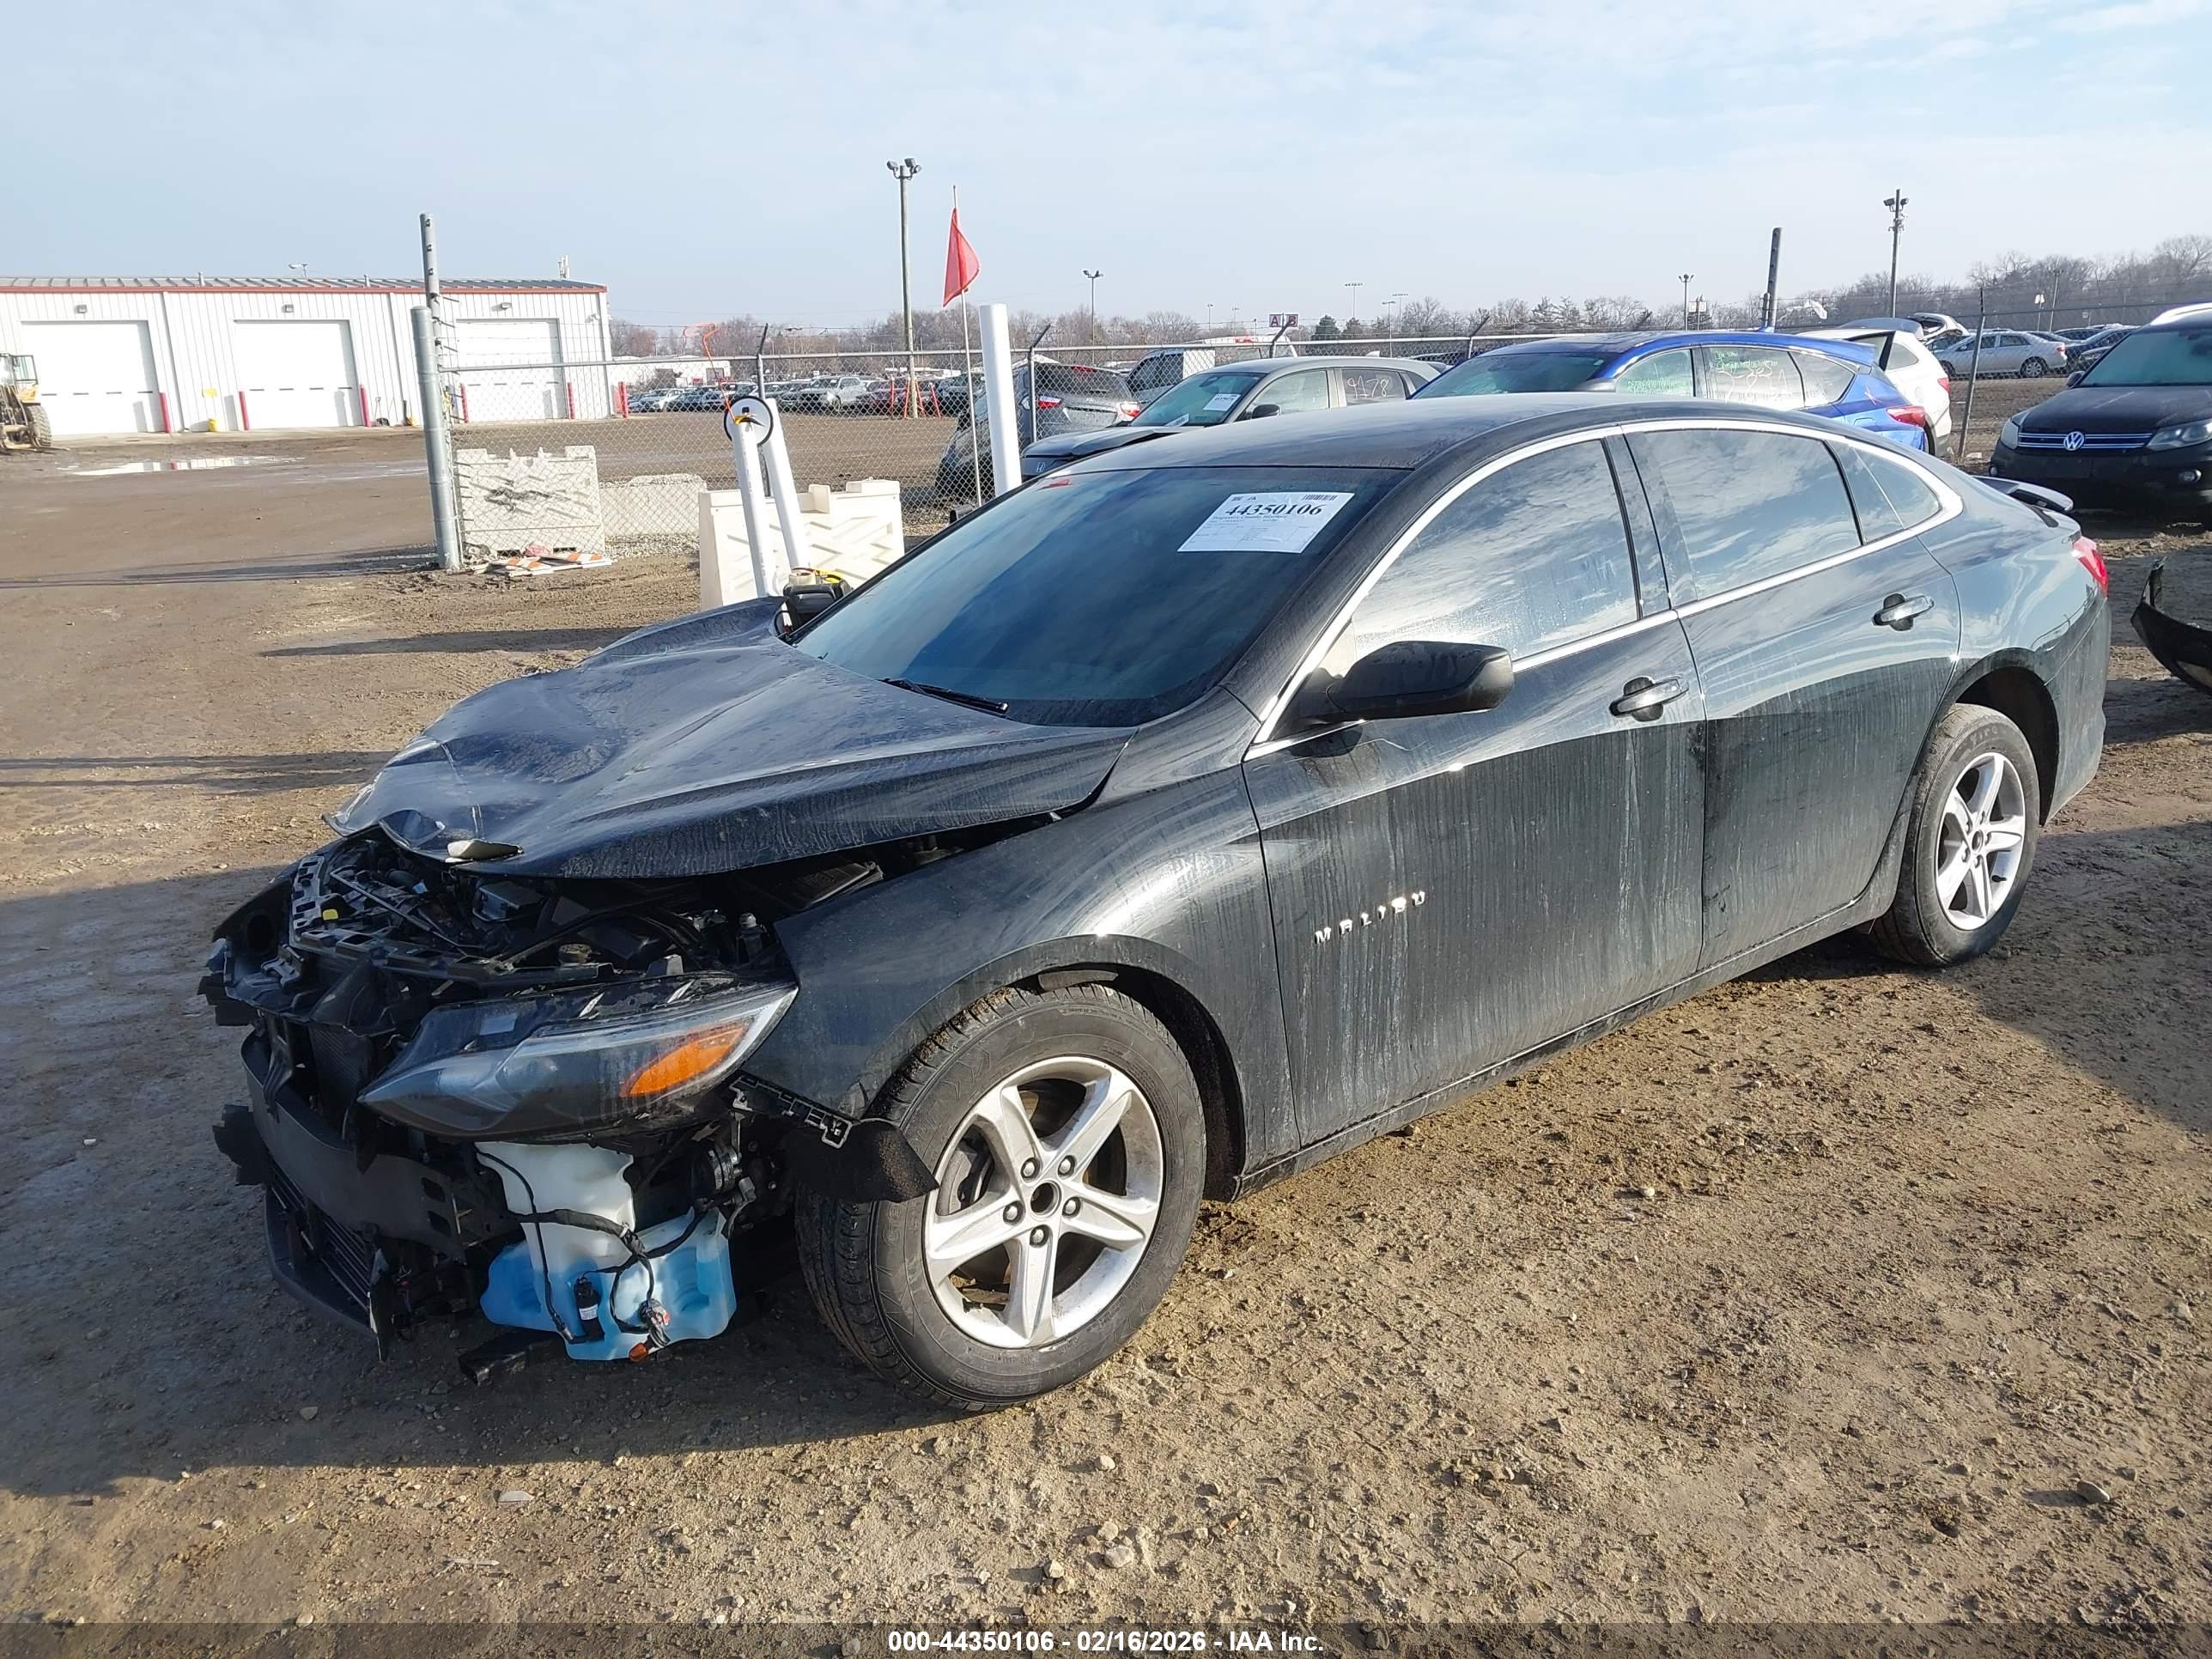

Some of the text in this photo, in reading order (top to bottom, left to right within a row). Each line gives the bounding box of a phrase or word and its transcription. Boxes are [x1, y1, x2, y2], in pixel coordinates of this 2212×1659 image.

[1270, 315, 1279, 327] A
[1288, 315, 1297, 326] B
[1347, 375, 1389, 399] 9178
[1224, 503, 1326, 515] 44350106
[1314, 890, 1425, 945] MALIBU
